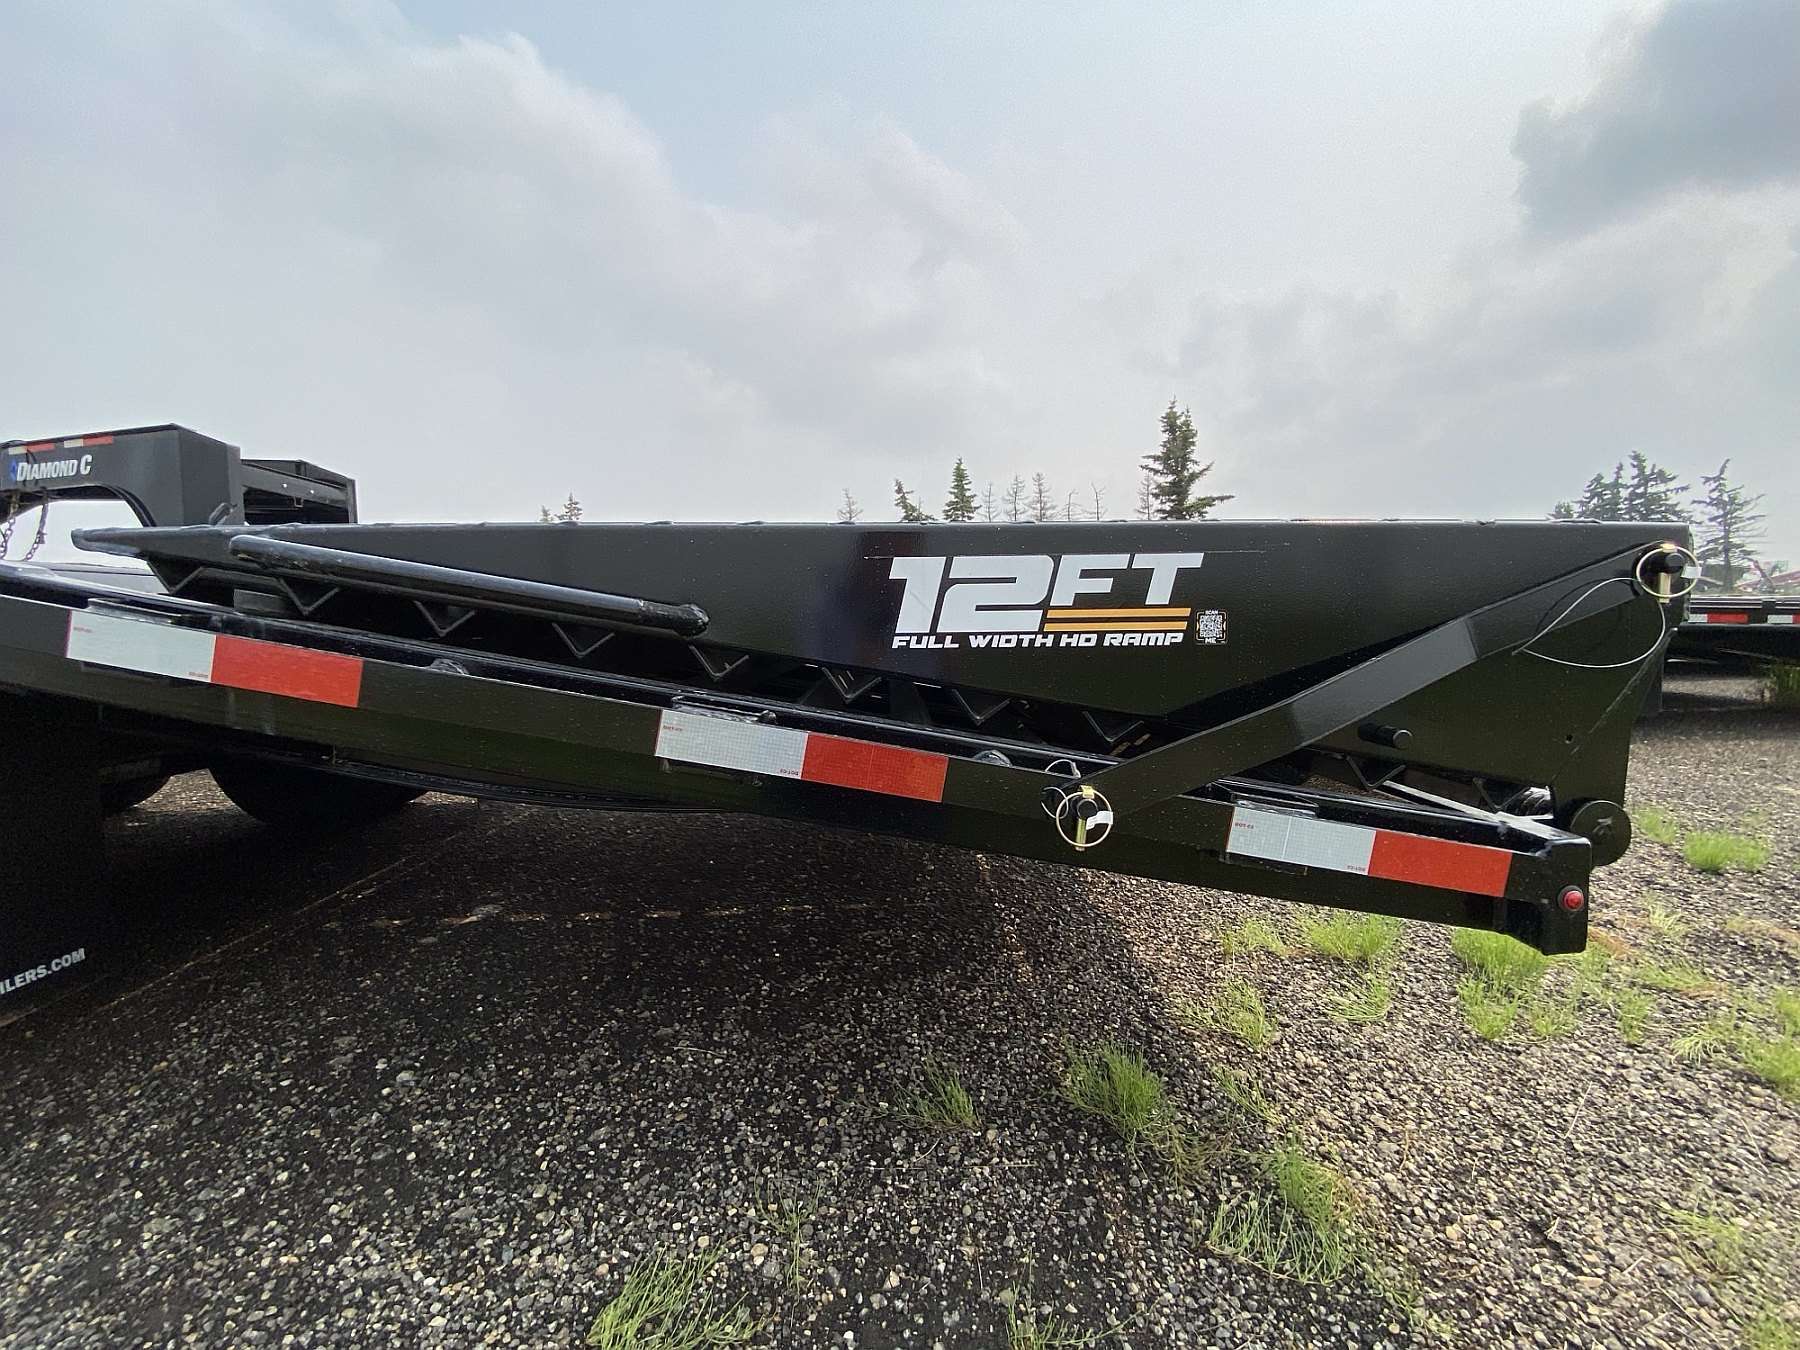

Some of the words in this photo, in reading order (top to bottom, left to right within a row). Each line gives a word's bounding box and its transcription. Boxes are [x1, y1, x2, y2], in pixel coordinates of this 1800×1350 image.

[16, 460, 78, 482] DIAMOND
[80, 454, 93, 475] C
[889, 553, 1205, 634] 12FT
[891, 635, 960, 649] FULL
[968, 634, 1055, 648] WIDTH
[1059, 633, 1098, 647] HD
[1103, 632, 1184, 646] RAMP
